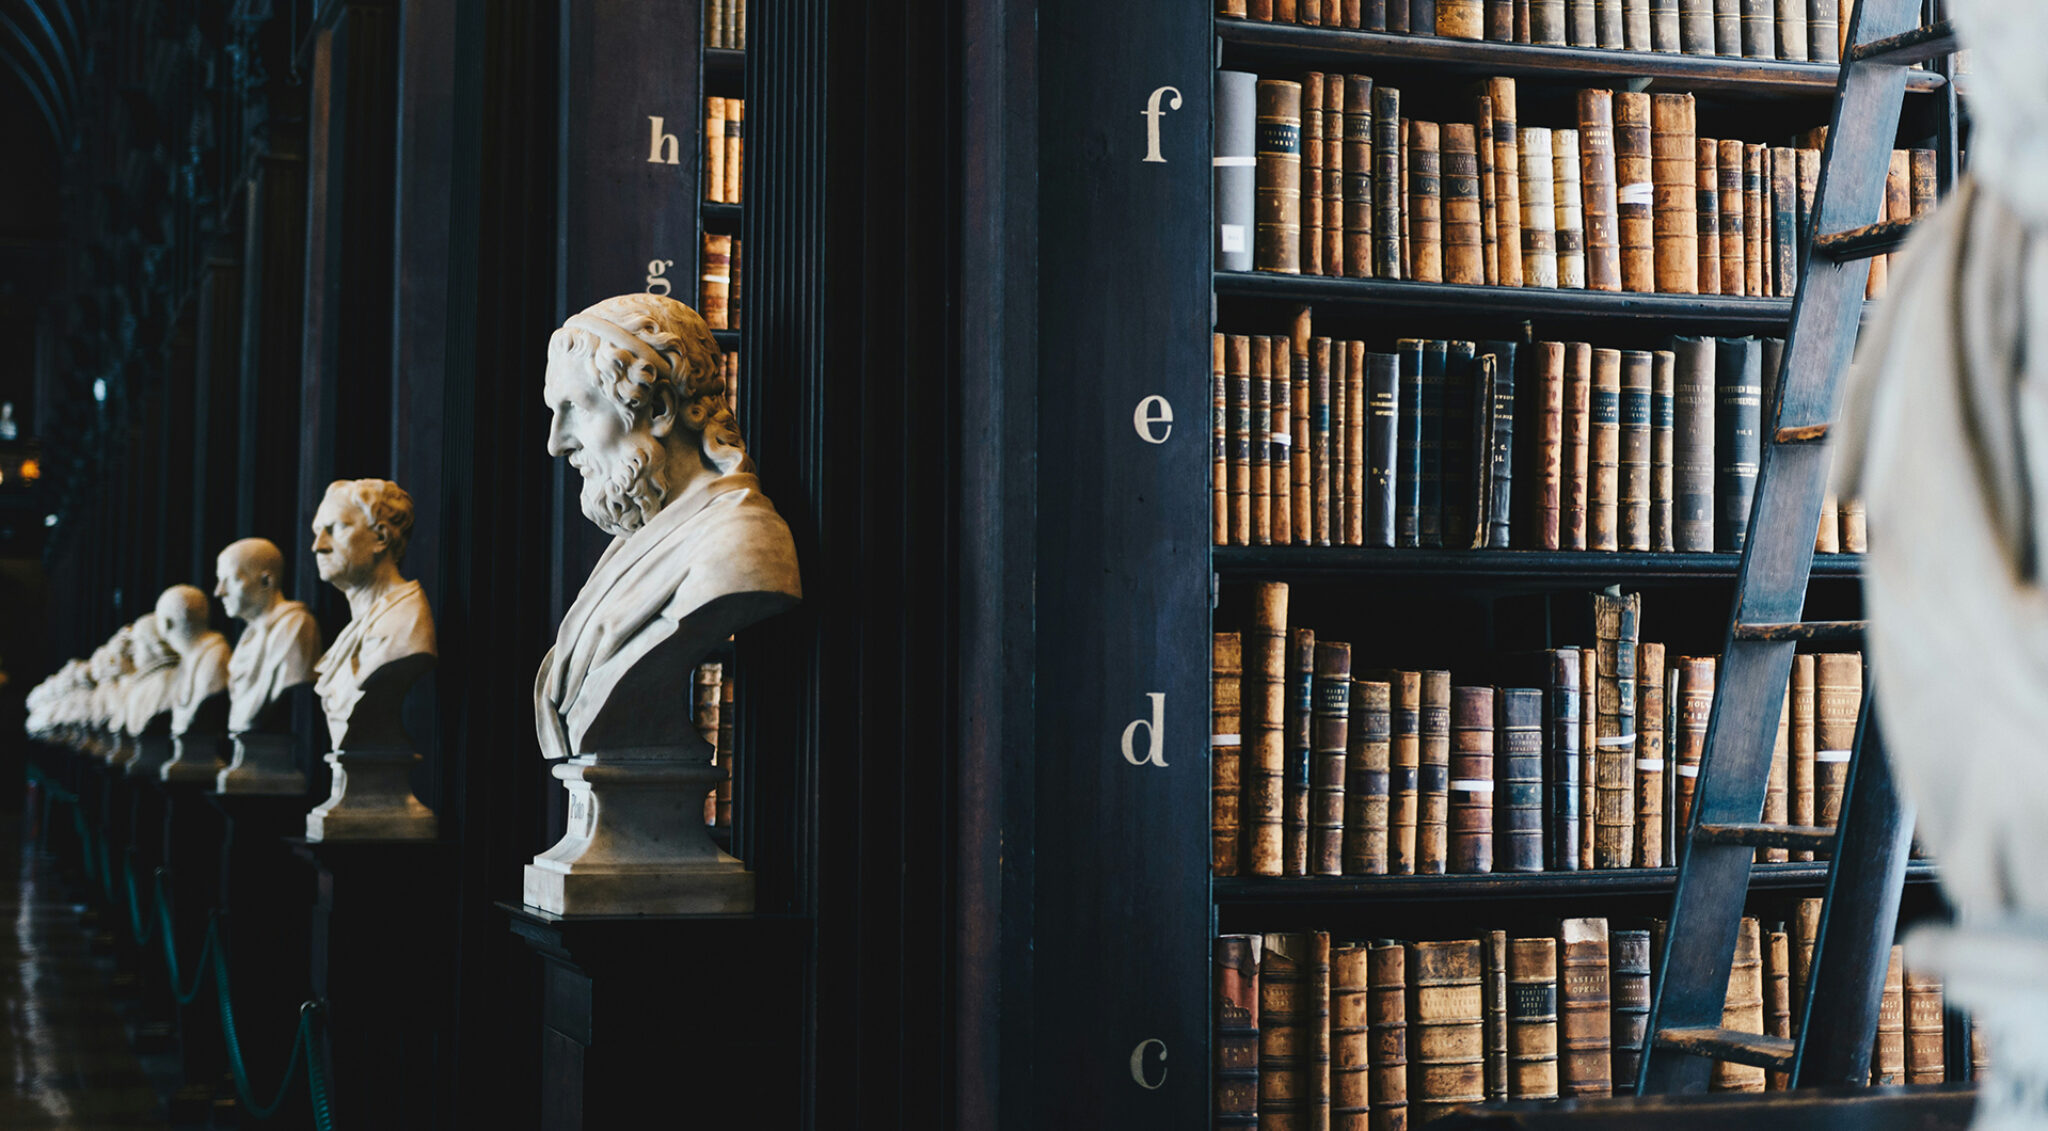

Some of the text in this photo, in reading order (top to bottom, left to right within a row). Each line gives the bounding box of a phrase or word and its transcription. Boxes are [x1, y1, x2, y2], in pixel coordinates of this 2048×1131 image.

[646, 115, 681, 164] h
[1141, 86, 1182, 163] f
[646, 259, 674, 297] g
[1134, 395, 1174, 444] e
[1121, 693, 1169, 767] d
[1130, 1038, 1168, 1089] c
